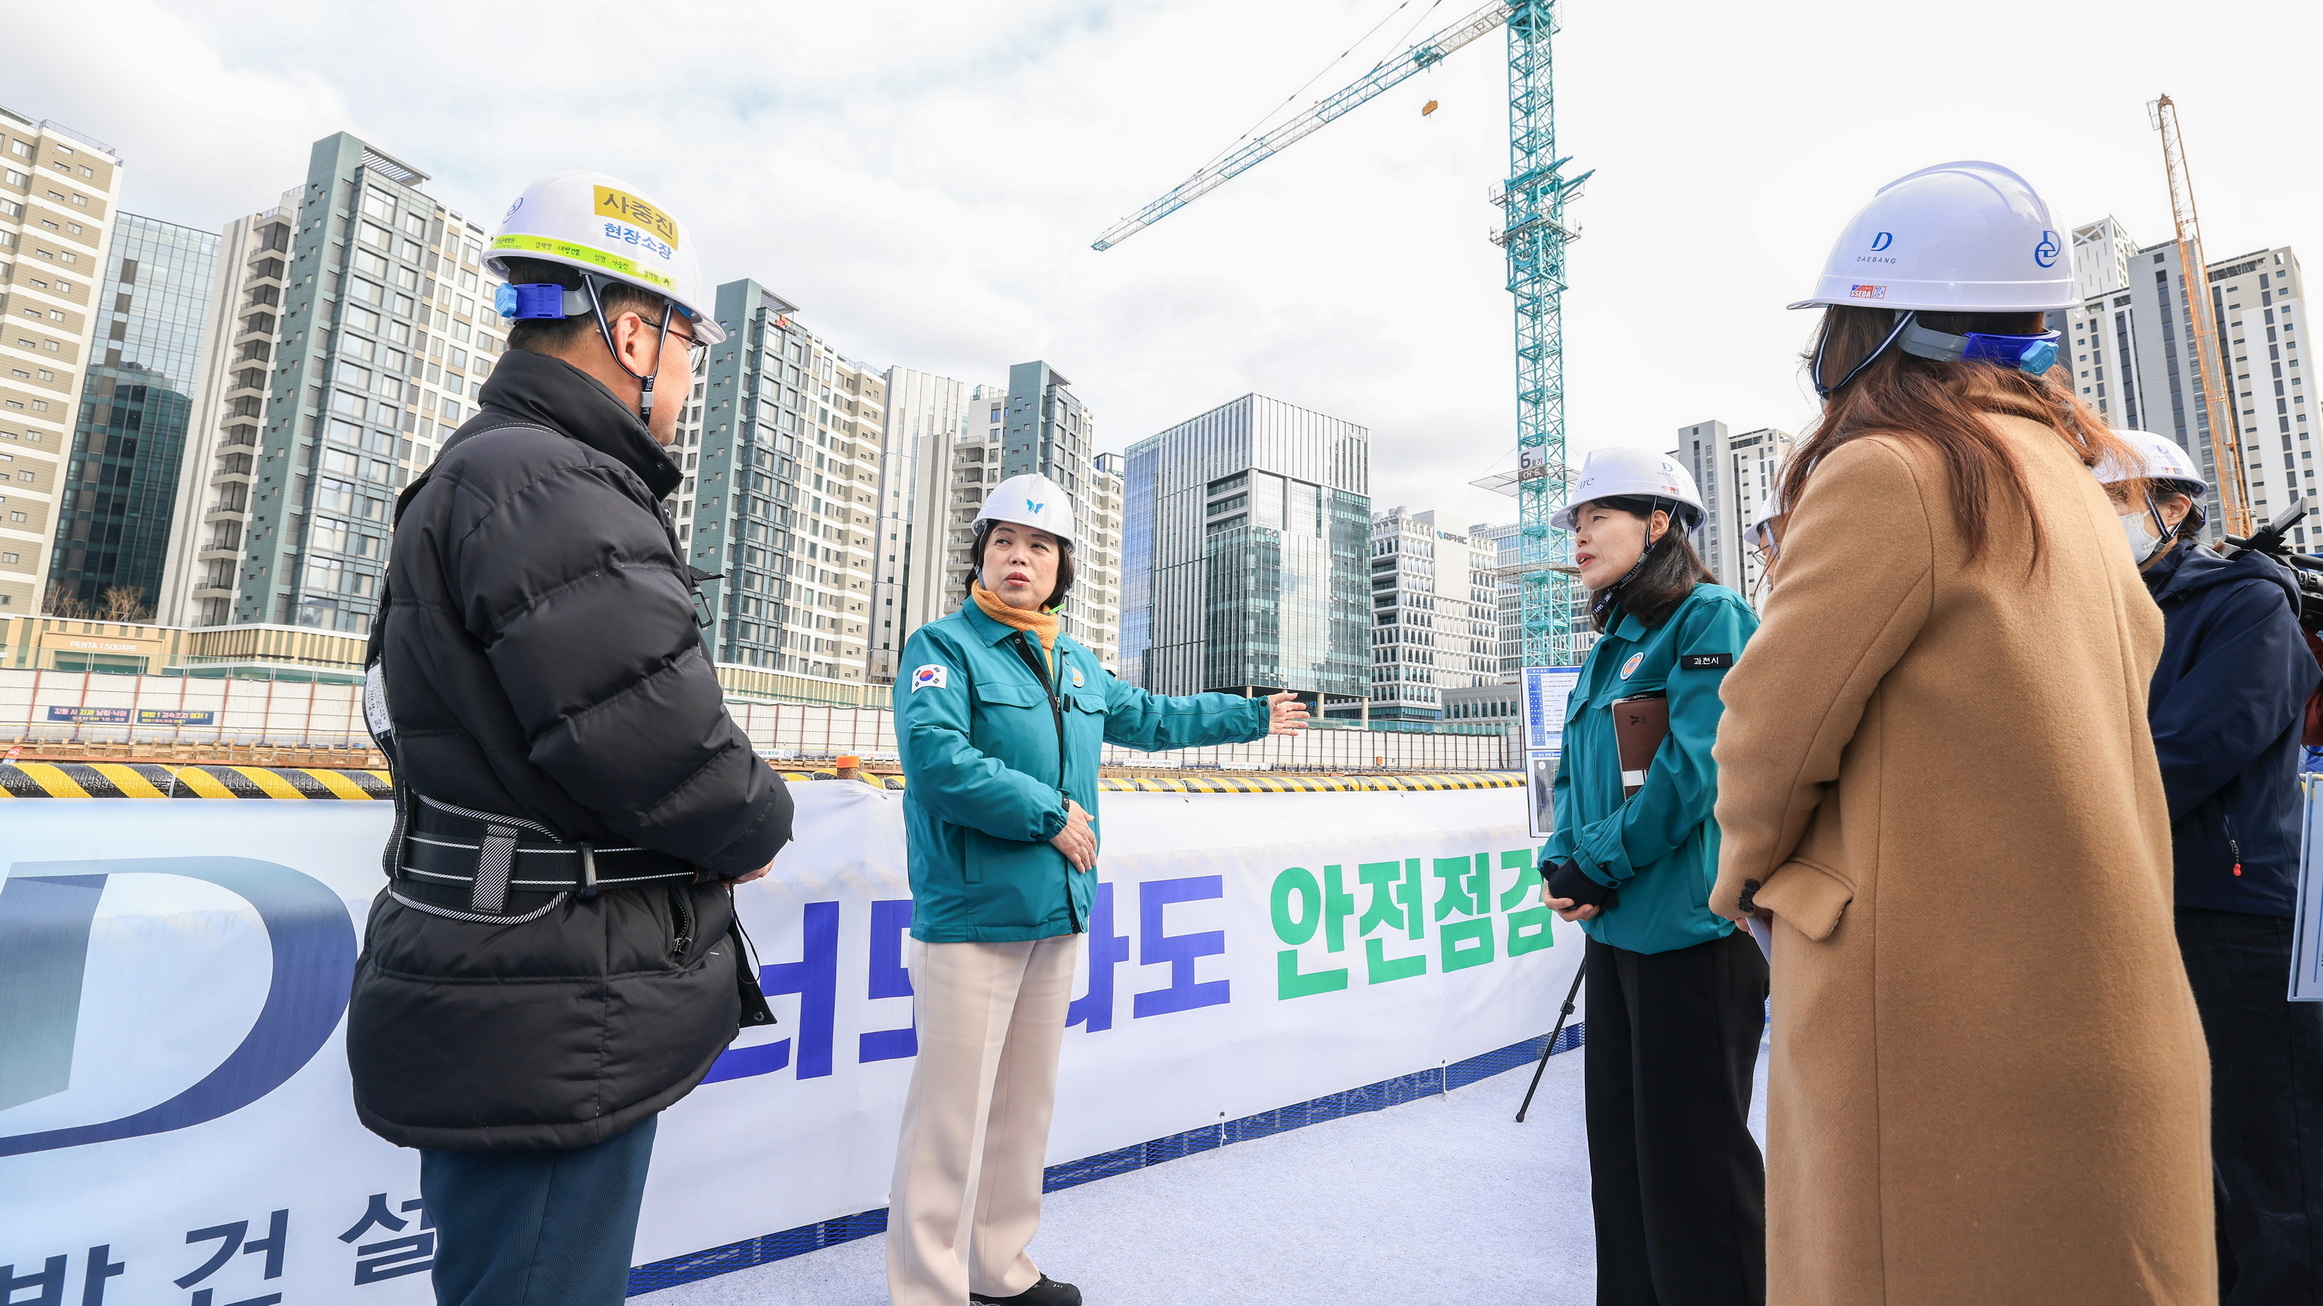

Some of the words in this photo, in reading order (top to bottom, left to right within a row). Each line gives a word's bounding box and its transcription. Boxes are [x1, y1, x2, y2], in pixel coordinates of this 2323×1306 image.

[603, 193, 673, 240] 사중진
[604, 222, 672, 260] 현장소장
[1870, 231, 1893, 252] D
[1856, 256, 1897, 264] DAEBANG
[70, 641, 97, 649] PENTA
[104, 643, 138, 652] SQUARE
[1693, 656, 1719, 665] 과천시
